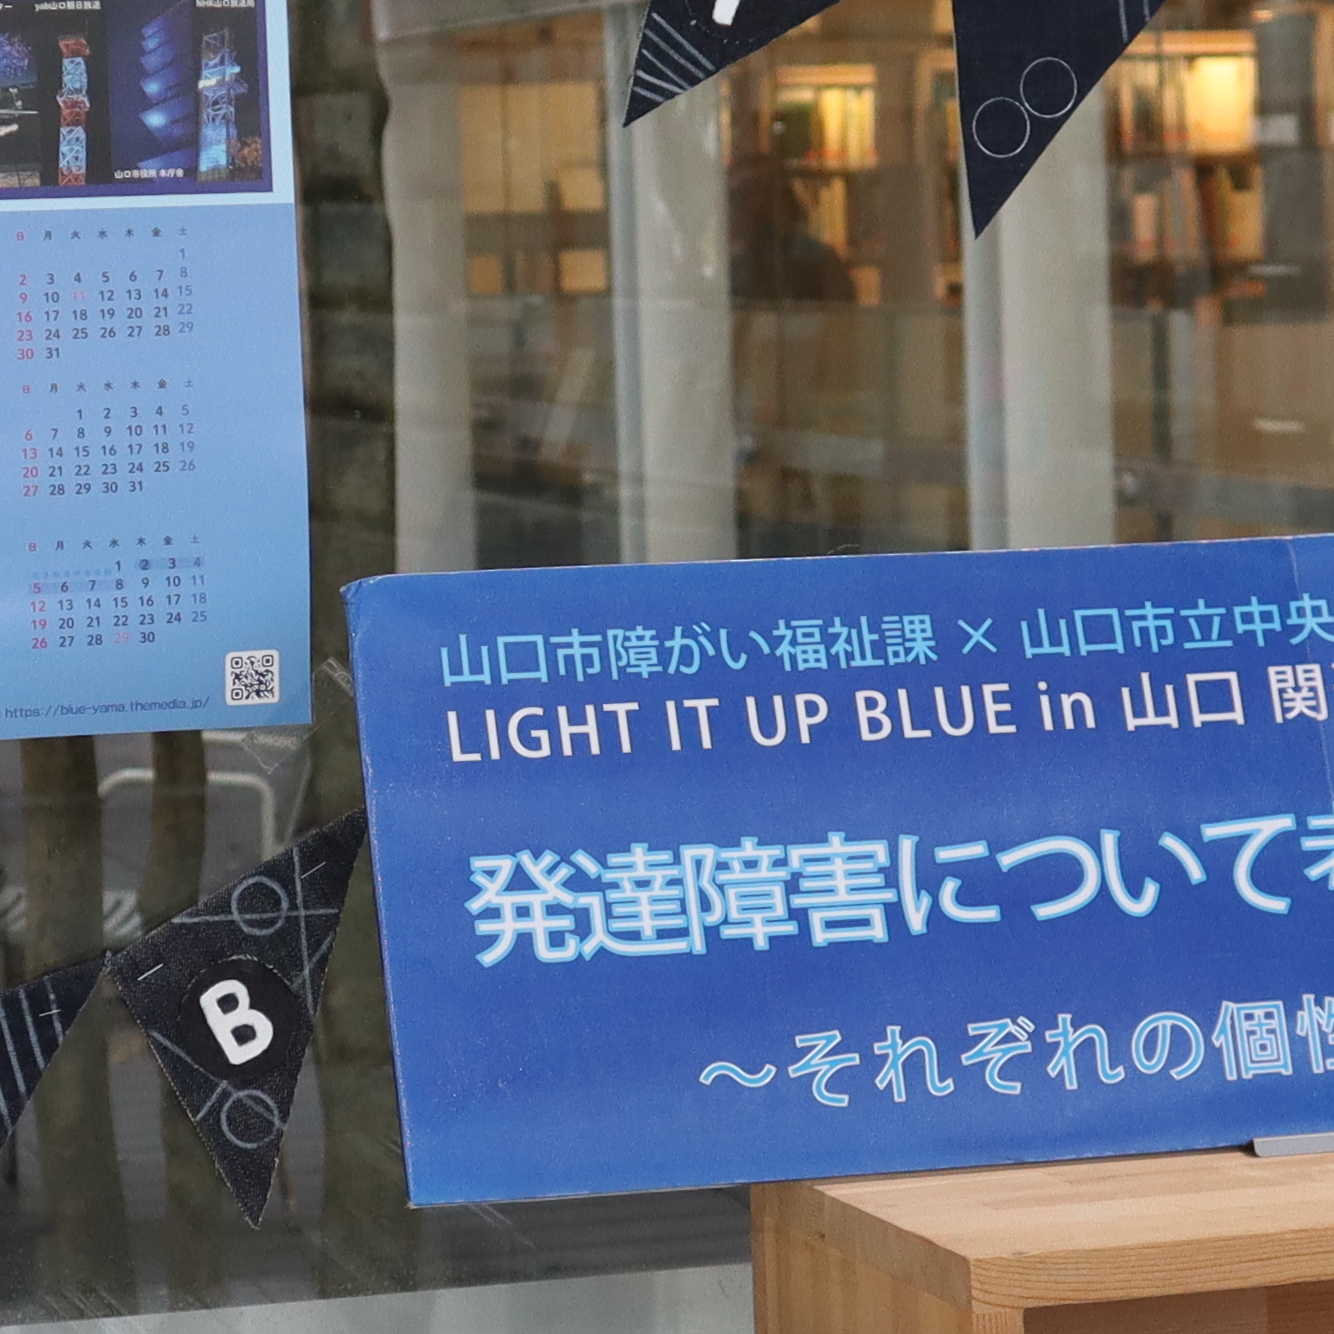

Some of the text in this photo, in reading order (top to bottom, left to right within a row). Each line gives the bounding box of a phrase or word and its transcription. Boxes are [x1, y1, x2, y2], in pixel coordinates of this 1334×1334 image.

[439, 611, 938, 687] 山口市障がい福祉課
[445, 699, 641, 763] LIGHT
[665, 696, 721, 753] IT
[744, 690, 830, 749] UP
[858, 681, 1017, 743] BLUE
[1037, 678, 1096, 733] in
[1120, 669, 1248, 732] 山口
[198, 978, 275, 1066] B
